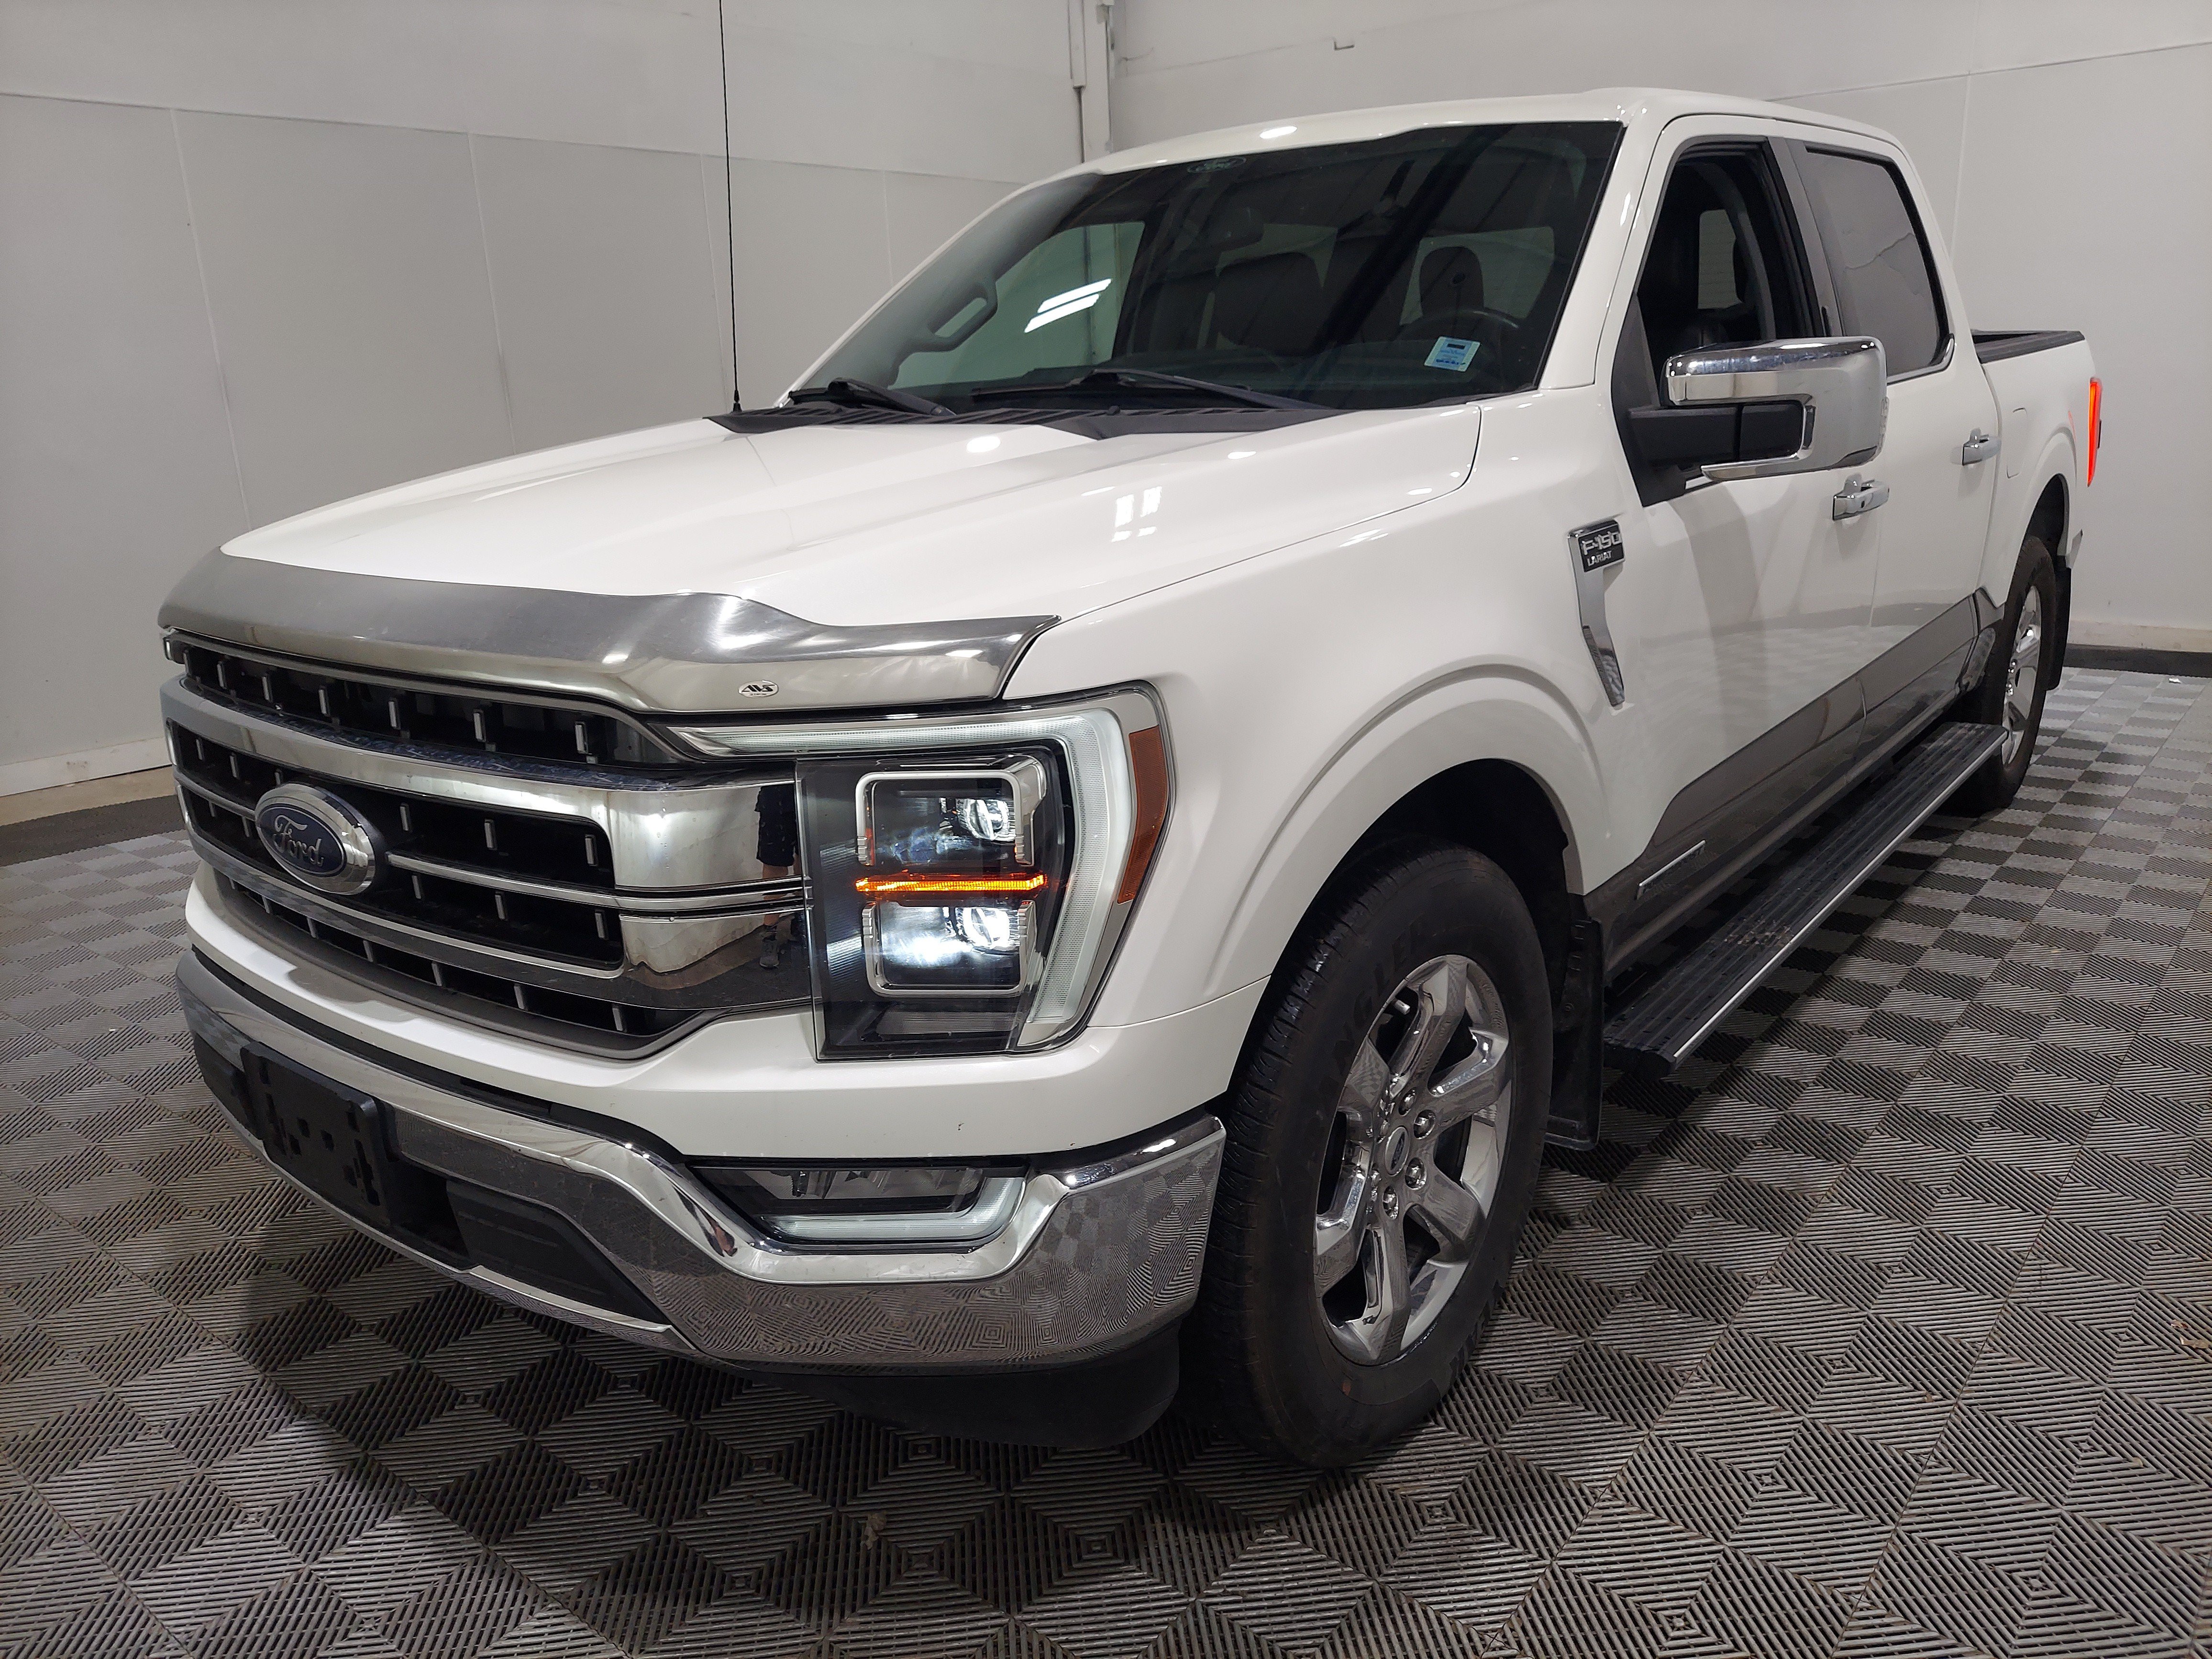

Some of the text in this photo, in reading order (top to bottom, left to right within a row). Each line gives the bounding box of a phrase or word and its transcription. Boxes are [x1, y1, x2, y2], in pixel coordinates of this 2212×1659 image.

[1582, 531, 1623, 555] F-150
[1587, 550, 1612, 566] LARIAT
[741, 684, 775, 692] AVS
[273, 814, 324, 867] Ford
